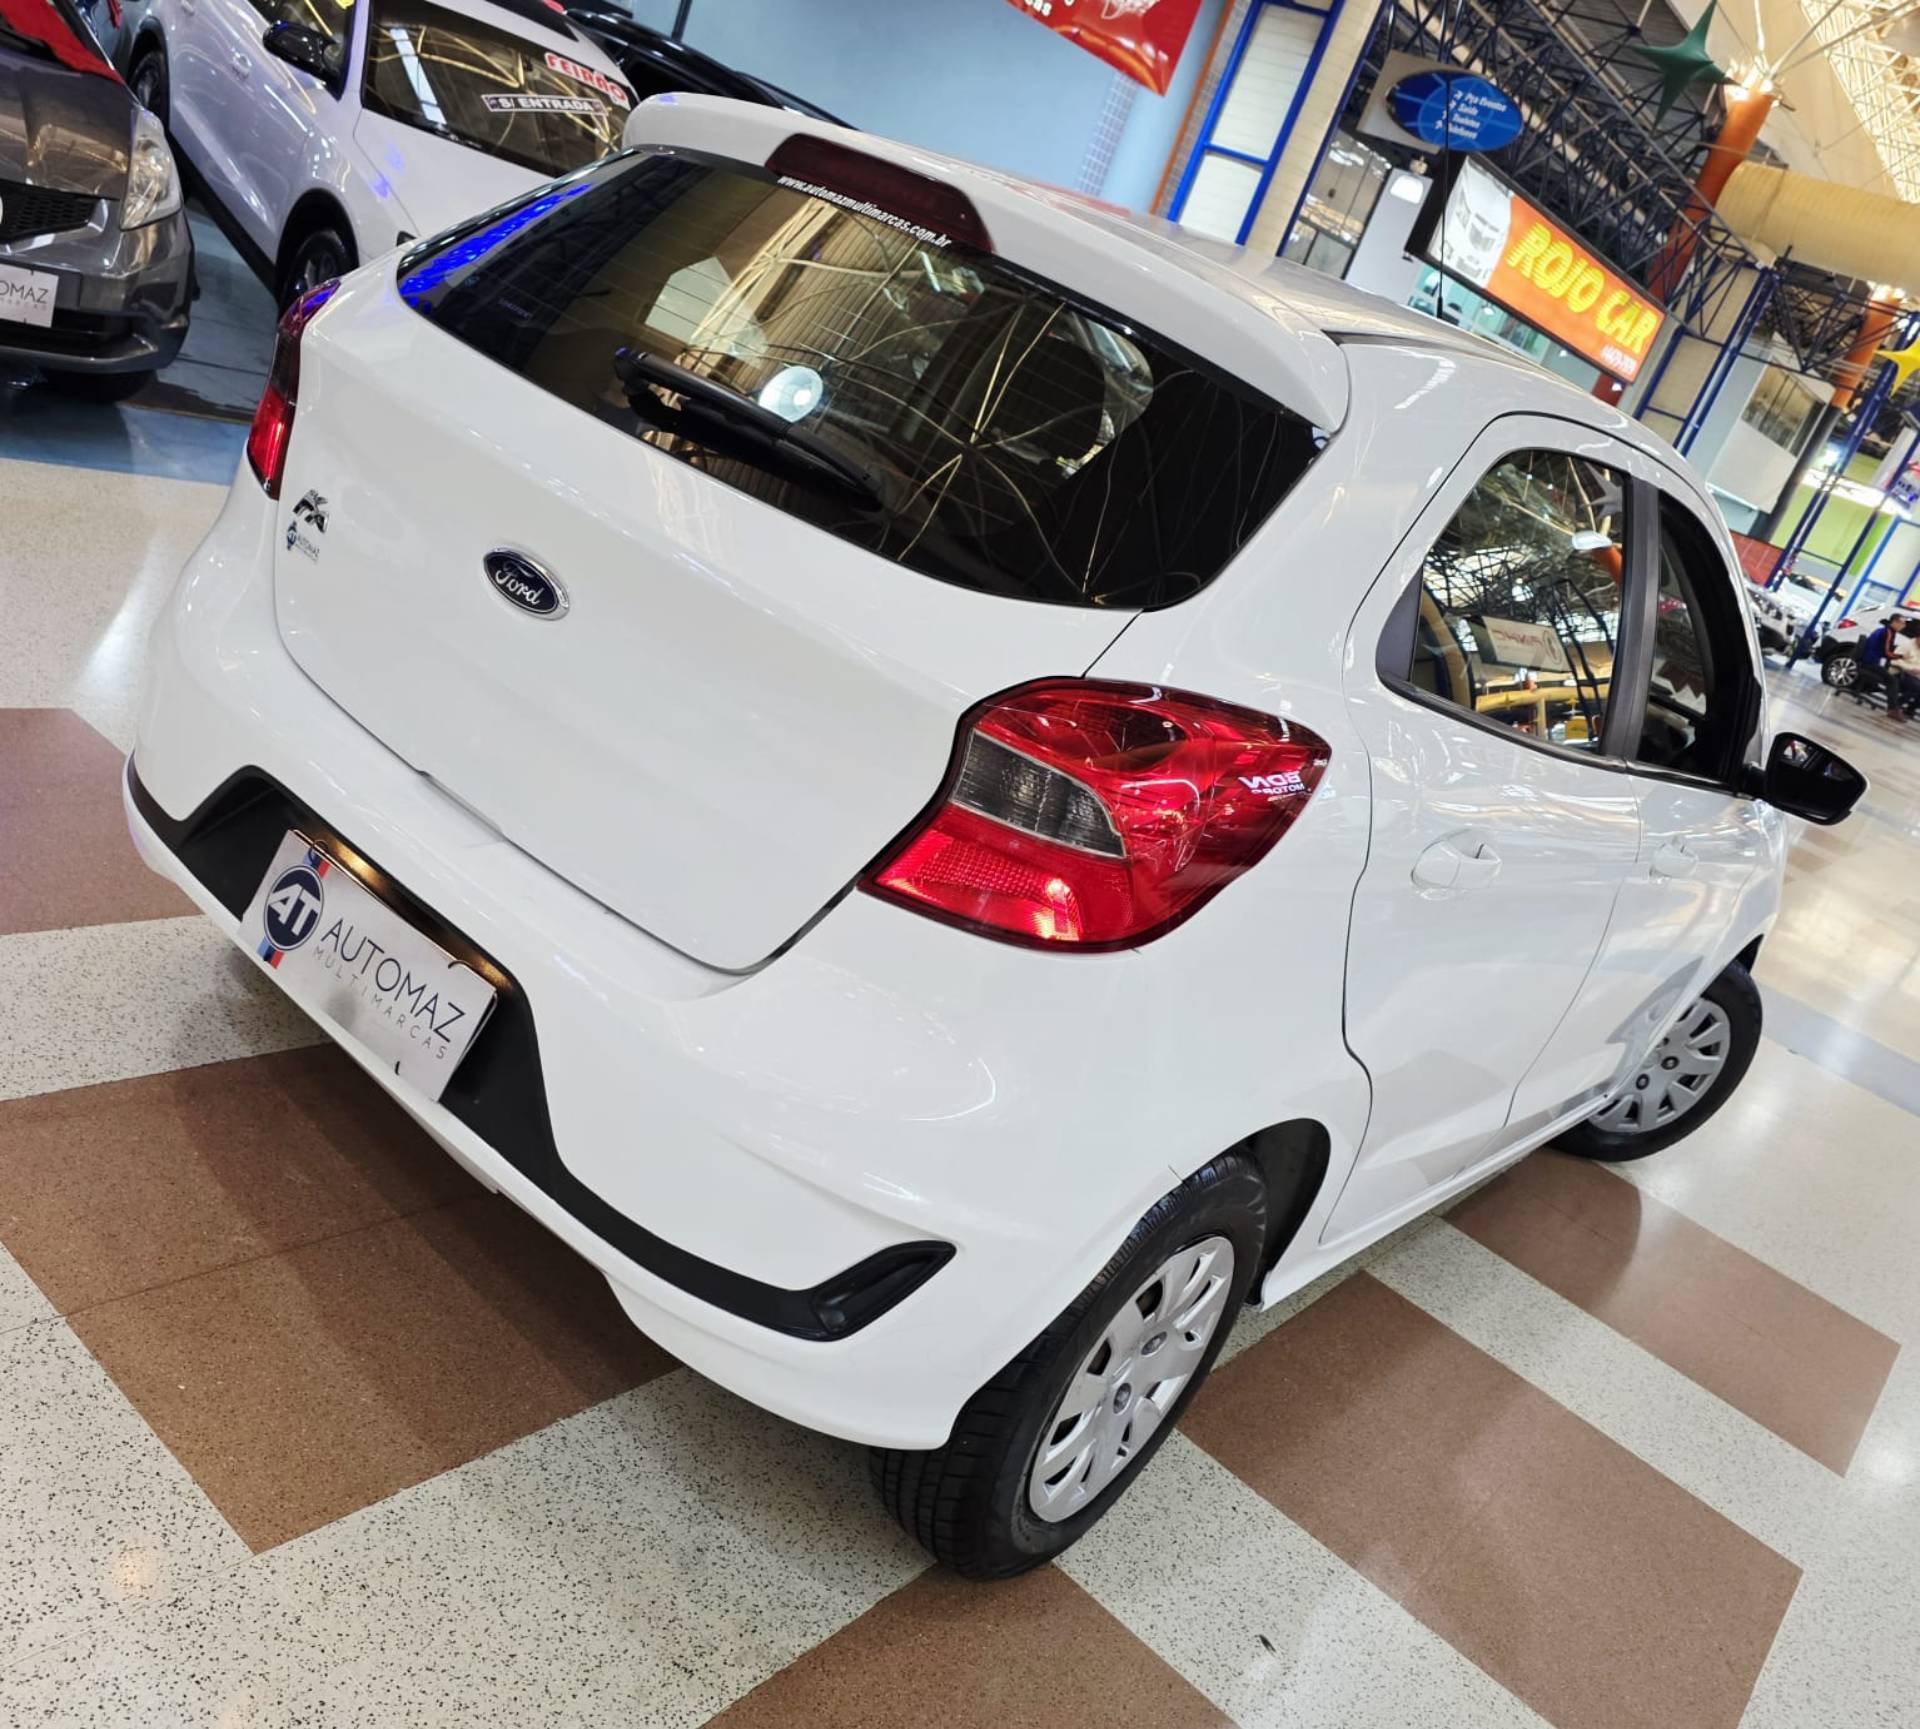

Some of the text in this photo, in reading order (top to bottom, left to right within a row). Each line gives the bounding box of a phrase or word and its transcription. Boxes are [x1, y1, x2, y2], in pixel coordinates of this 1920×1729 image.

[517, 98, 594, 112] ENTRADA
[776, 175, 952, 248] www.automazmultimarcas.com.br
[1505, 222, 1658, 355] ROJO CAR
[495, 560, 545, 605] Ford
[313, 946, 449, 1060] MULTIMARCAS
[320, 917, 466, 1043] AUTOMAZ
